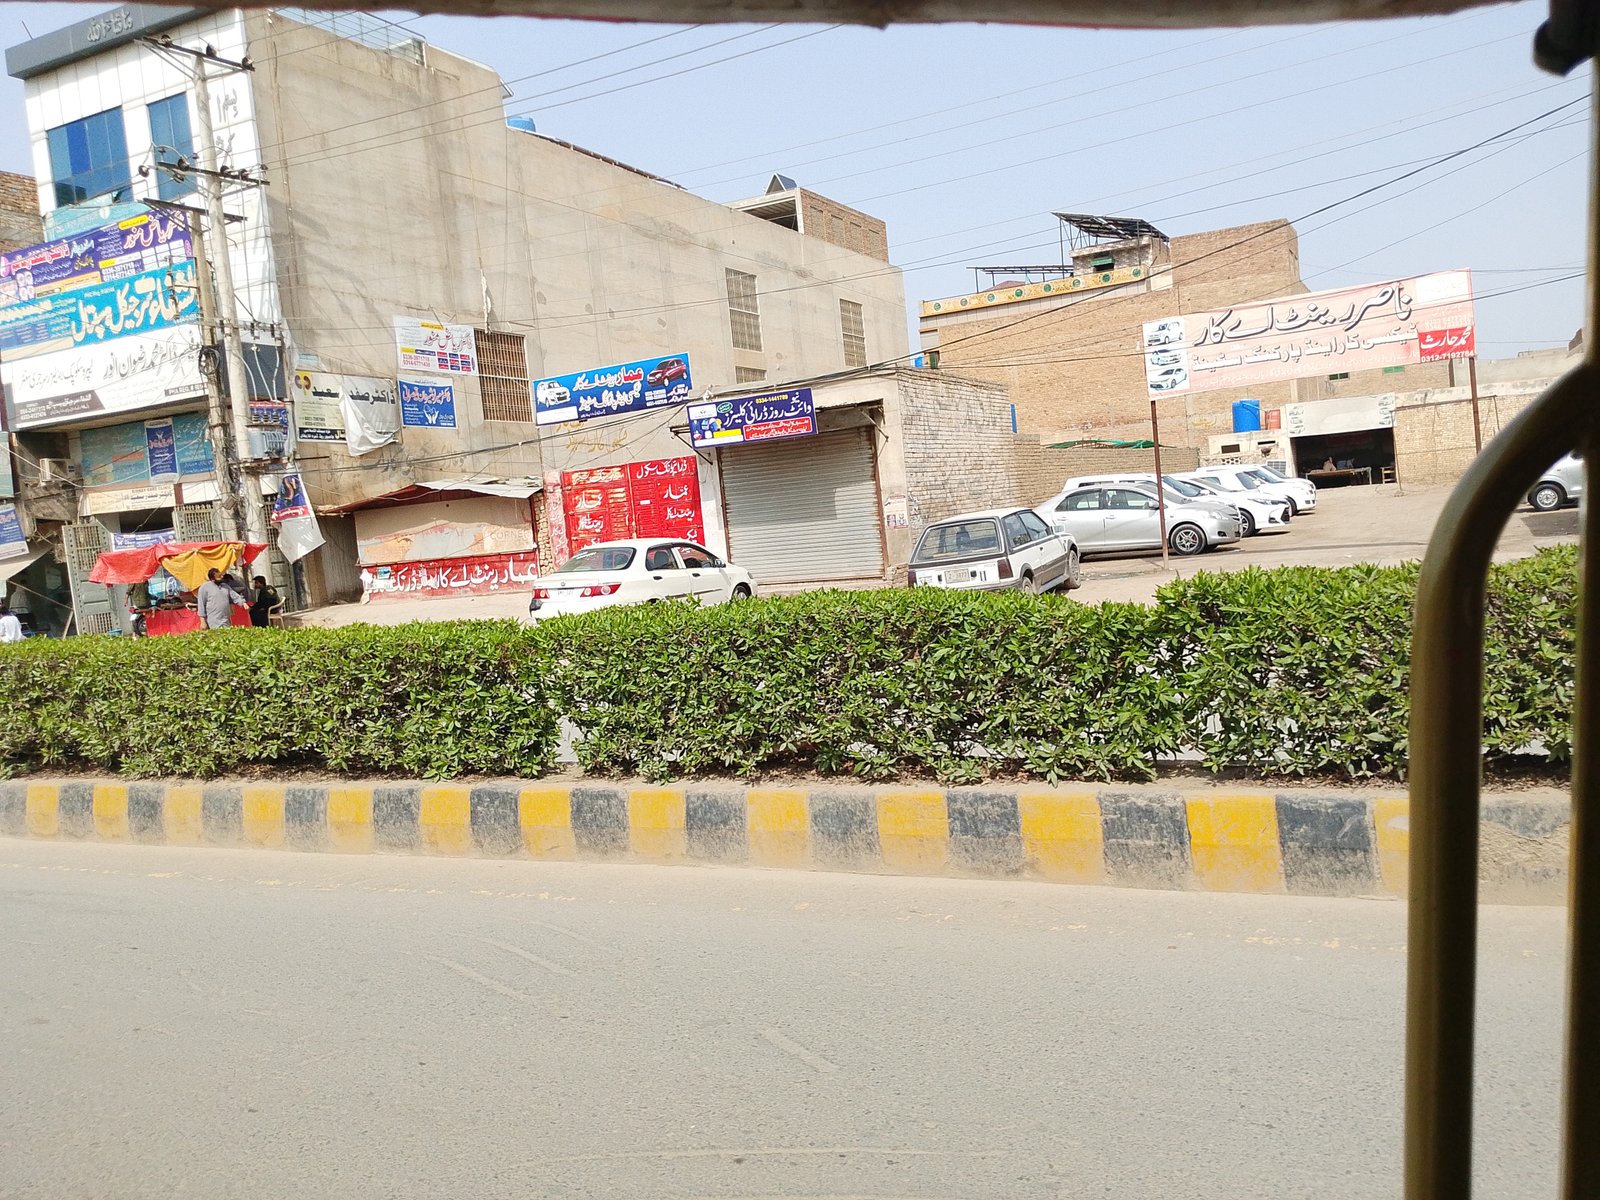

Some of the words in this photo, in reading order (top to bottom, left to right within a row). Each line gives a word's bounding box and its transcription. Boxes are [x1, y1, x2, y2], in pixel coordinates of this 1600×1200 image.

[1275, 302, 1356, 331] رینٹ
[1343, 284, 1413, 332] ناصر
[71, 299, 113, 341] ہسپتال
[1193, 309, 1233, 347] کار
[1224, 303, 1274, 339] اے
[1338, 334, 1360, 355] کار
[1362, 322, 1419, 350] ٹیکسی
[1420, 329, 1459, 349] حارث
[1453, 324, 1472, 347] محمد
[119, 345, 146, 378] رضوان
[1244, 343, 1302, 363] پارکنگ
[102, 351, 118, 380] انور
[616, 366, 644, 386] عمار
[349, 386, 370, 402] صفد
[370, 388, 396, 406] ڈاکٹر
[790, 391, 800, 404] نیو
[723, 401, 748, 428] کلینرز
[744, 402, 769, 425] ڈرائی
[768, 406, 785, 421] روز
[784, 400, 812, 417] وائٹ
[636, 461, 659, 479] سکول
[575, 490, 603, 509] عمار
[663, 484, 689, 500] عمار
[450, 563, 471, 588] اے
[470, 564, 499, 590] رینٹ
[499, 552, 538, 584] عمار
